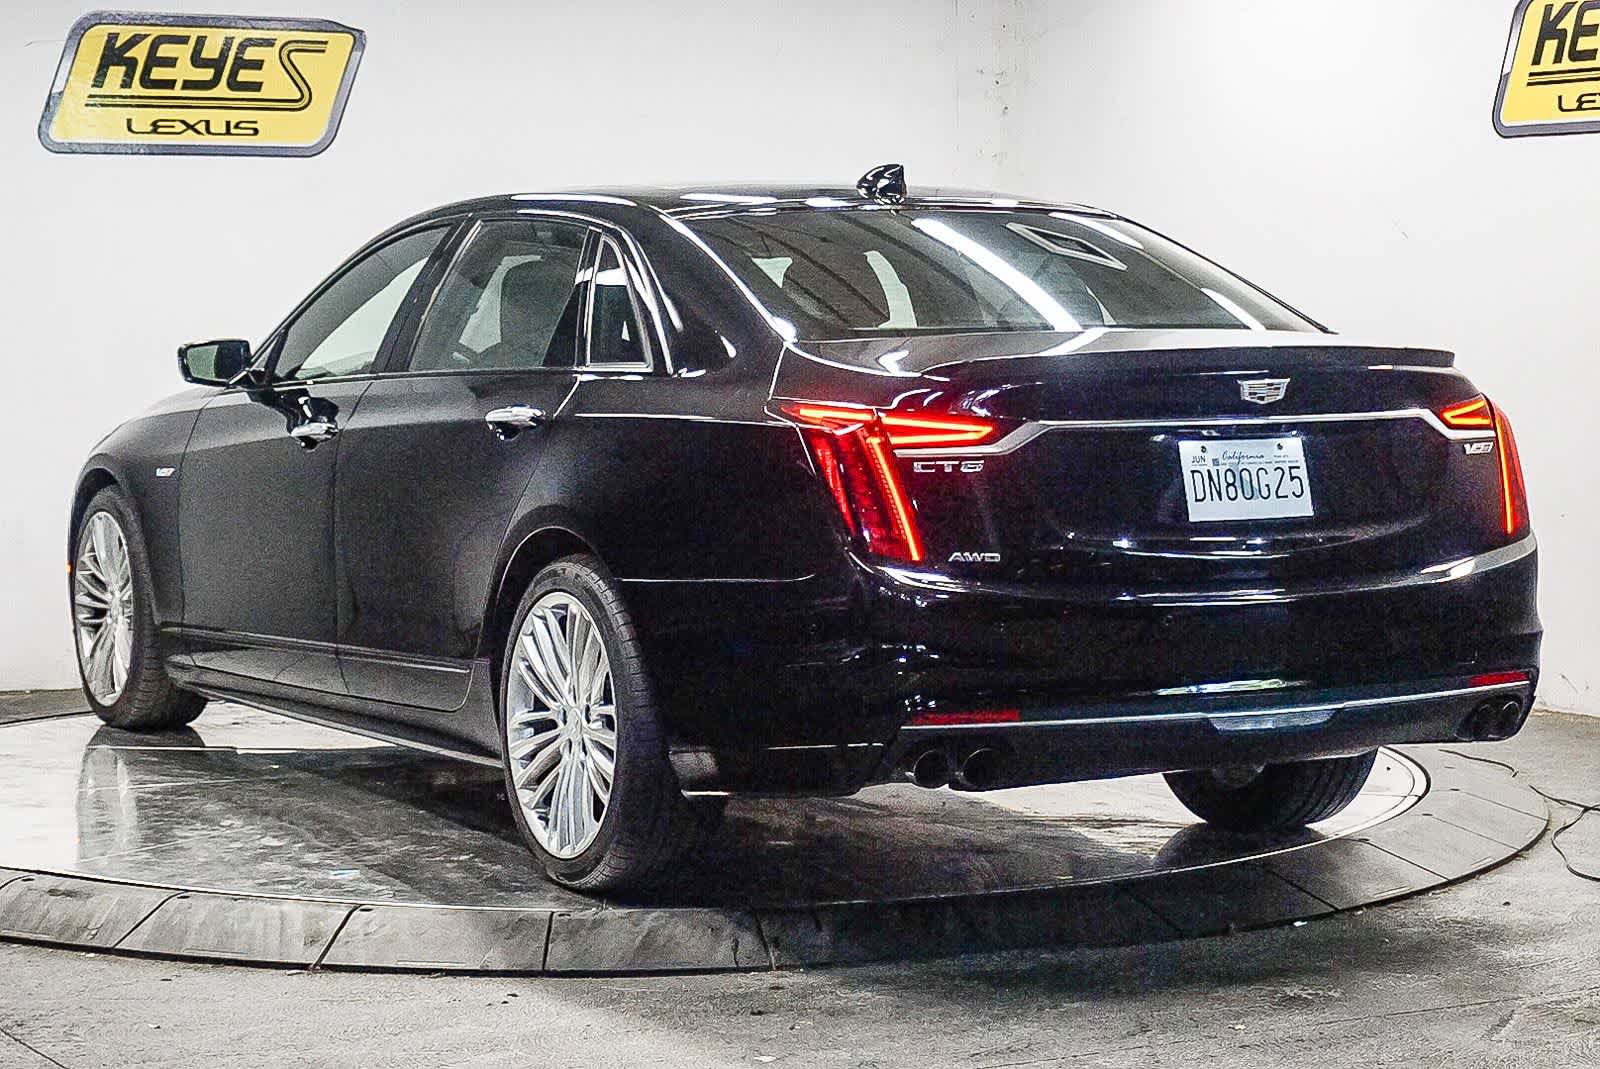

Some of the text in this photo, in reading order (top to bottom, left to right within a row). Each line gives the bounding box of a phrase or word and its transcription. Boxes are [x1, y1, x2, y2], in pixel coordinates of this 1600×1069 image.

[88, 33, 329, 103] KEYES
[126, 118, 260, 137] LEXUS
[1191, 455, 1206, 464] JUN
[1222, 449, 1265, 465] California
[948, 552, 1000, 562] AWD
